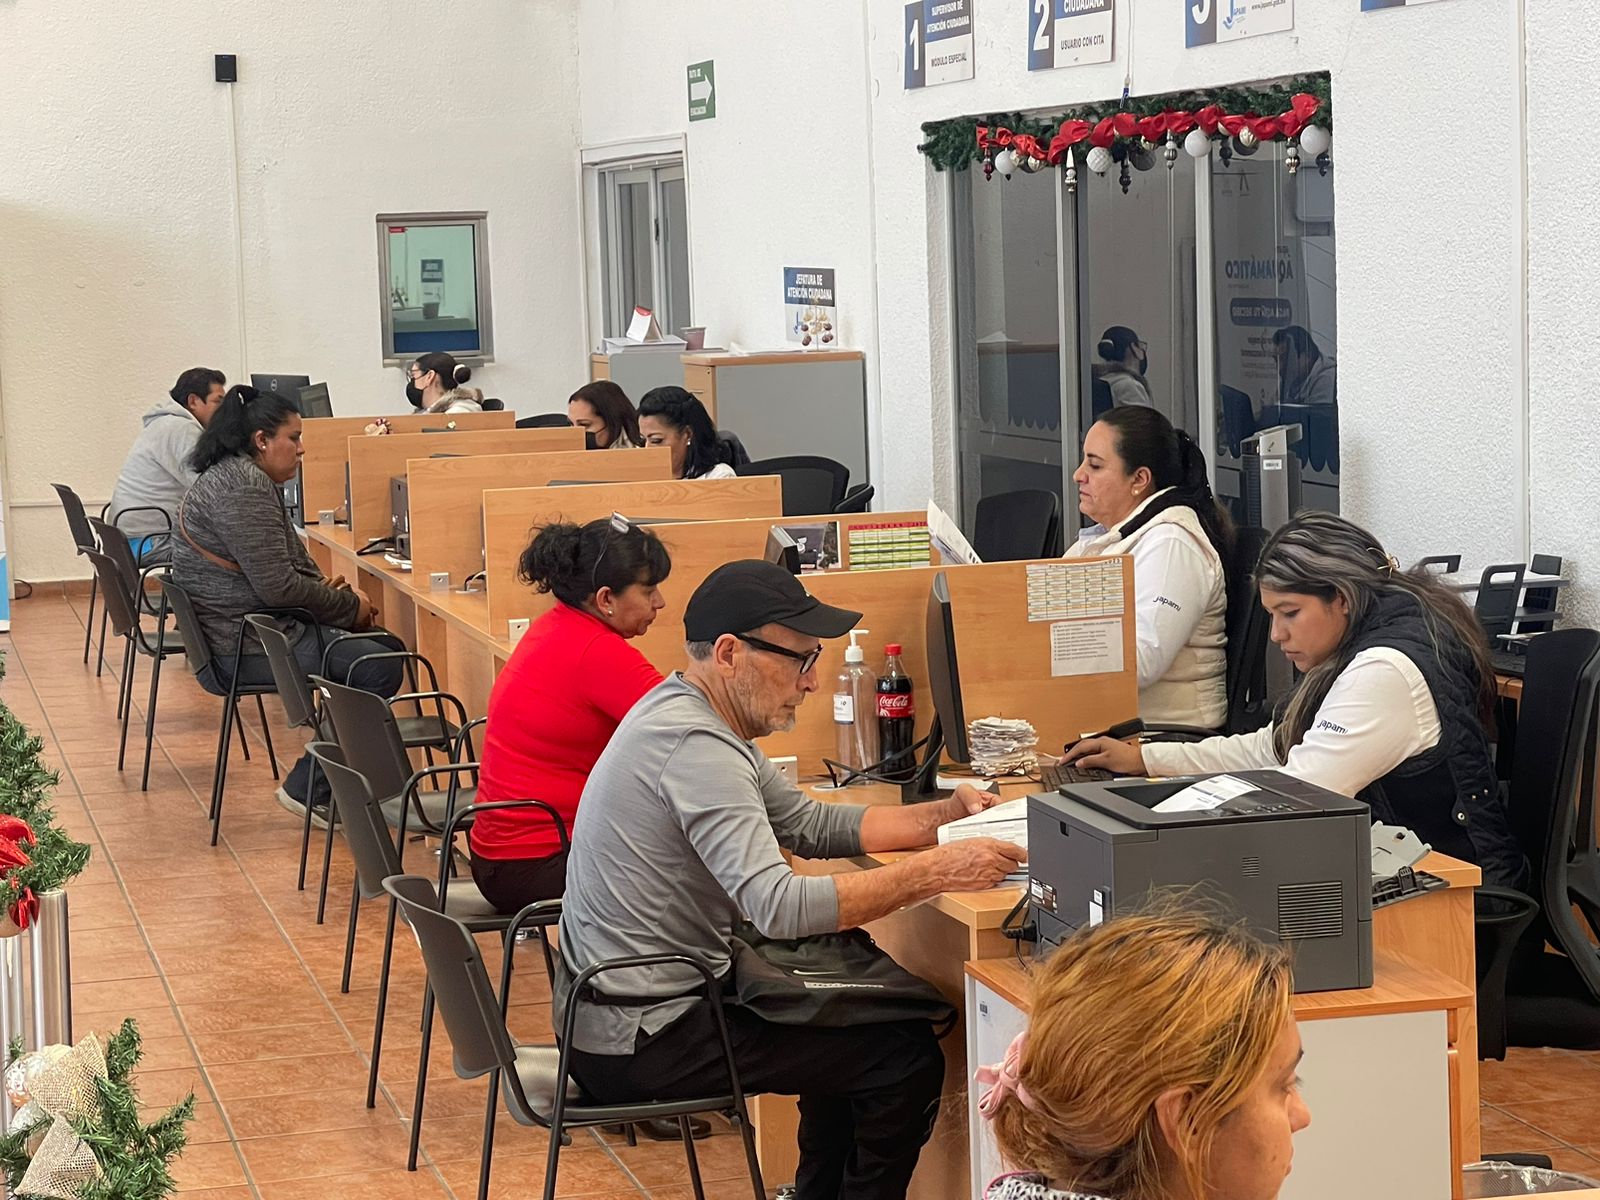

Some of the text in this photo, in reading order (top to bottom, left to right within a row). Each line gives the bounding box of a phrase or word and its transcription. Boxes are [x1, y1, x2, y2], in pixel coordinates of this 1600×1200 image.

[947, 15, 970, 29] CIUDADANA
[1033, 0, 1050, 51] 2
[909, 19, 920, 71] 1
[1061, 34, 1105, 51] USUARIO CON CITA
[948, 52, 967, 65] ESPECIAL
[816, 274, 823, 286] DE
[808, 287, 833, 301] CIUDADANA
